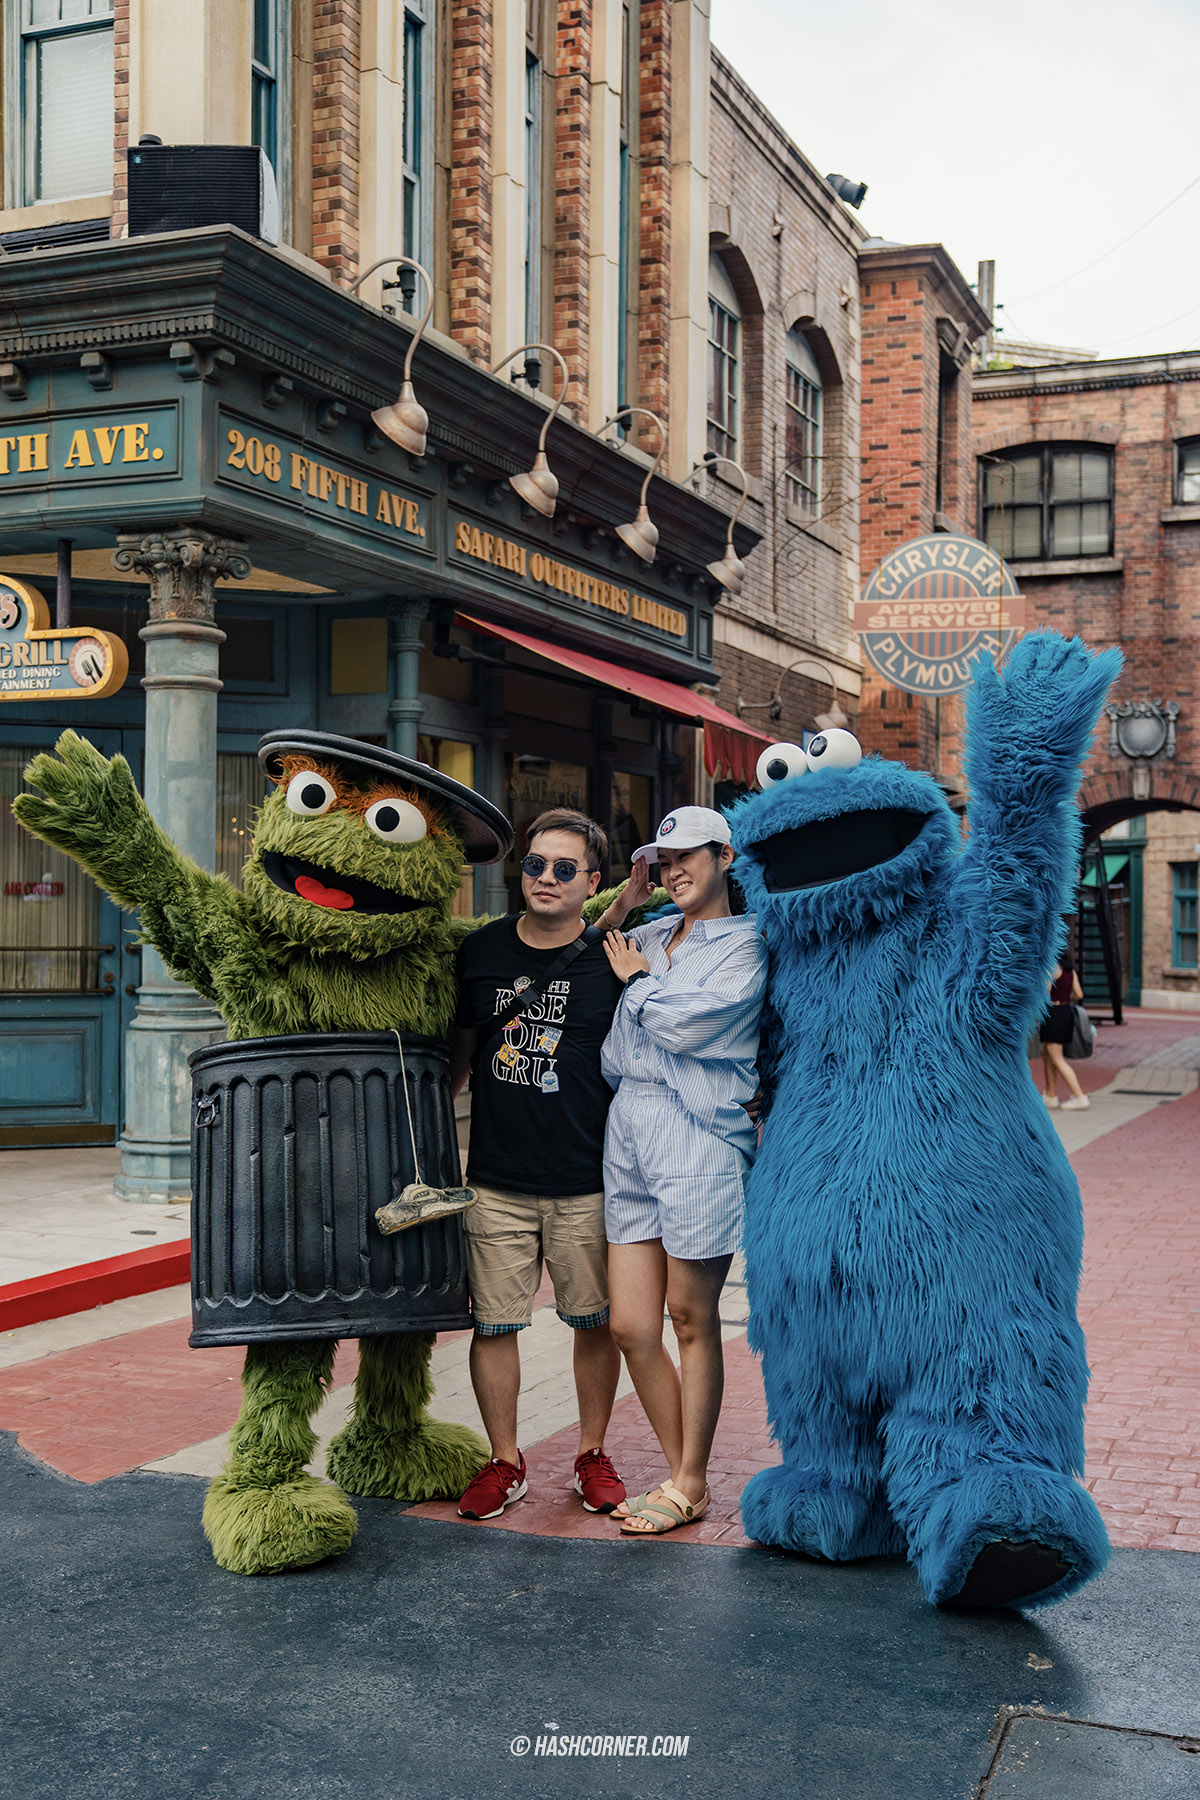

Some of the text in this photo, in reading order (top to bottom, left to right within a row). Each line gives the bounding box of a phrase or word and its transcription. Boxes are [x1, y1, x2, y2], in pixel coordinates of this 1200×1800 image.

[64, 423, 164, 468] AVE.
[227, 429, 426, 537] 208 FIFTH AVE.
[455, 521, 687, 637] SAFARI OUTFITTERS LIMITED
[875, 543, 1003, 597] CHRYSLER
[867, 612, 1011, 629] SERVICE
[878, 602, 1000, 615] APPROVED
[23, 667, 61, 679] DINING
[4, 881, 22, 896] AIR
